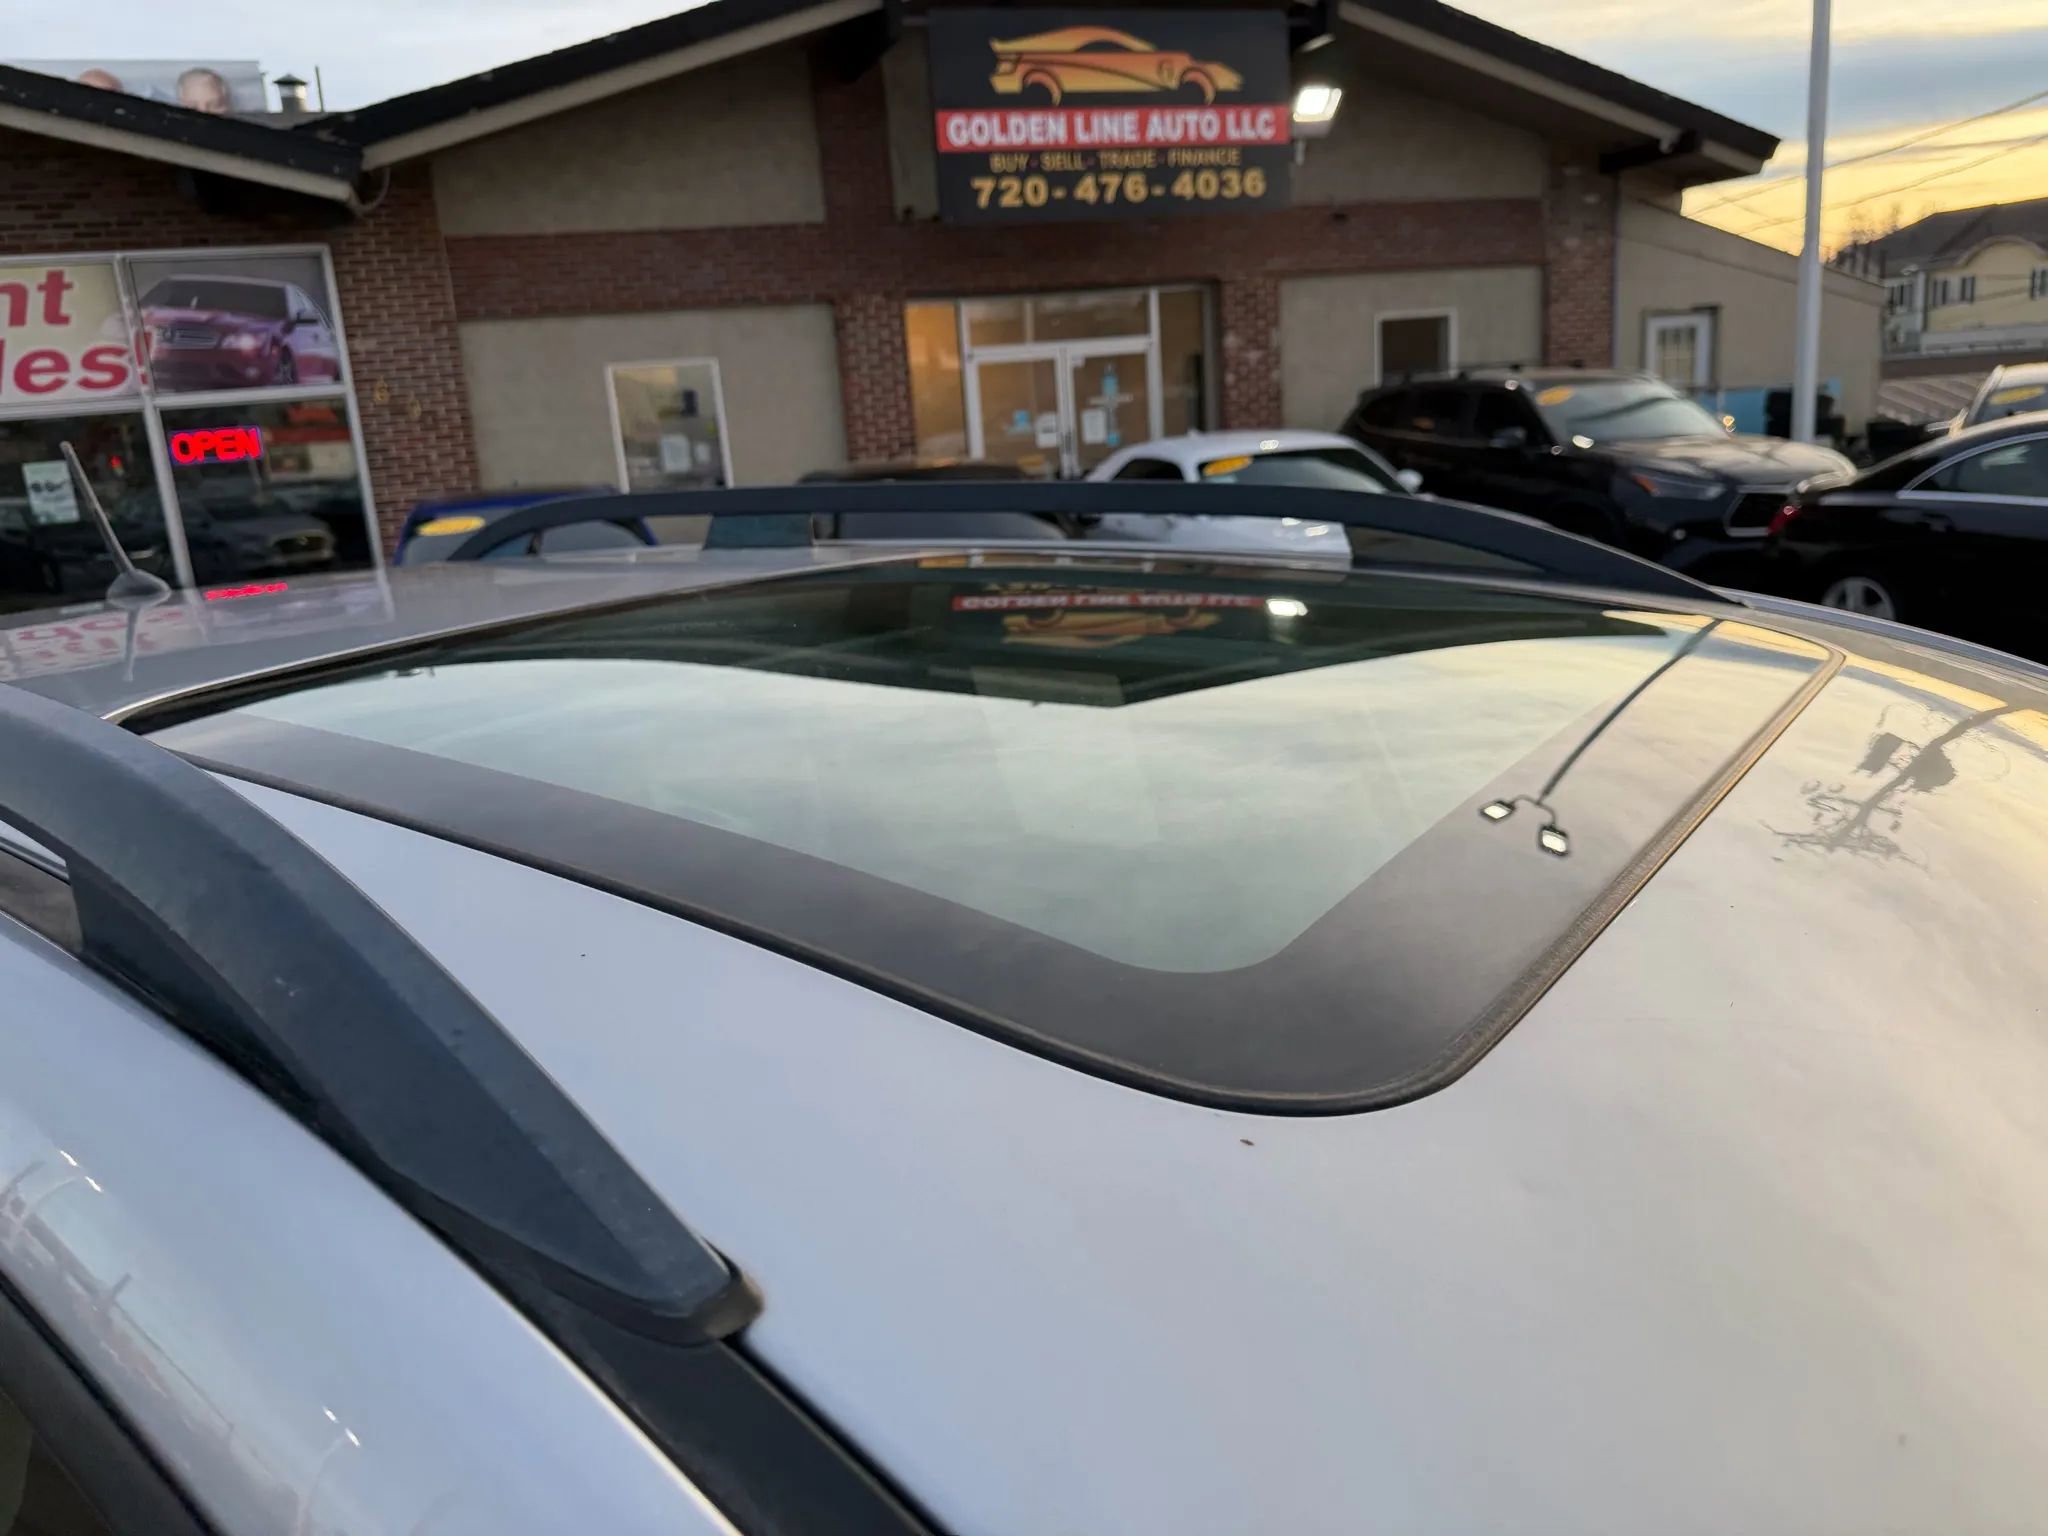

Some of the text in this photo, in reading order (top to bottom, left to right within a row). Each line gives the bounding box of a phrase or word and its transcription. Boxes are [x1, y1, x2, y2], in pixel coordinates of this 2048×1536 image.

[946, 107, 1276, 147] GOLDEN LINE AUTO LLC
[989, 147, 1241, 173] BUY SELL TRADE FINANCE
[171, 427, 261, 463] OPEN
